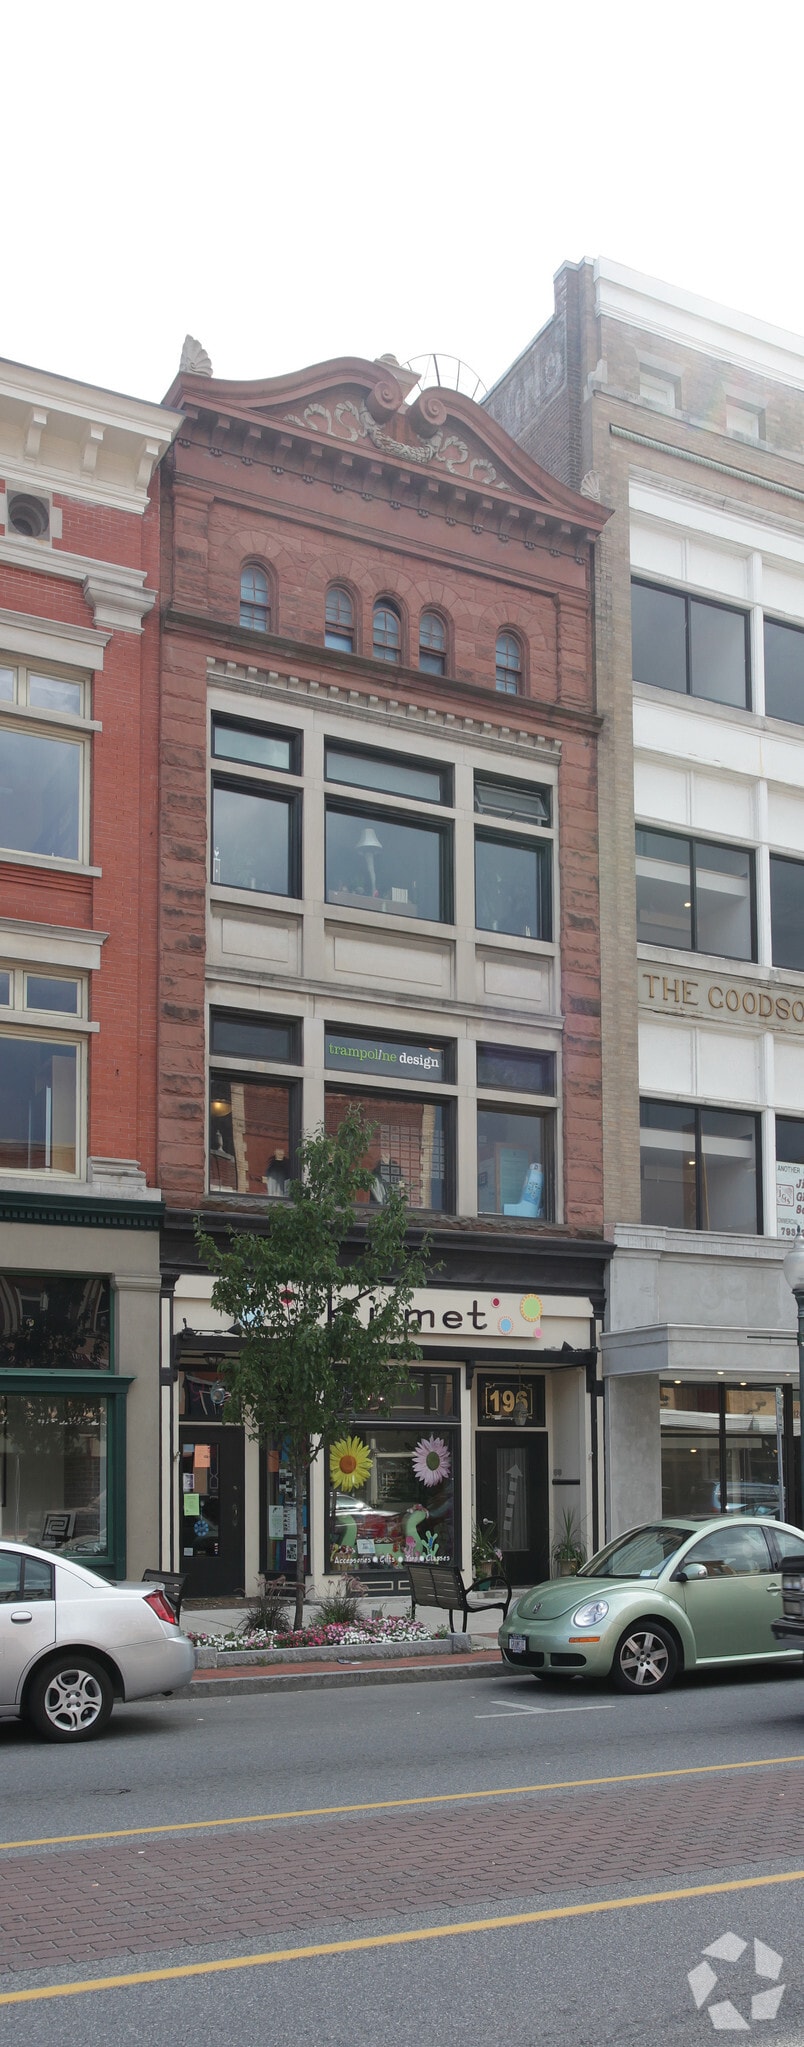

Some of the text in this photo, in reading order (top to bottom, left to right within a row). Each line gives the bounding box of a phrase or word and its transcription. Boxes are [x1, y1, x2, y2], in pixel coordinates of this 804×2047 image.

[643, 974, 698, 1005] THE
[399, 1053, 440, 1070] design
[778, 1165, 800, 1174] ANOTHER
[490, 1390, 528, 1412] 196
[334, 1556, 371, 1564] Accessories
[380, 1554, 395, 1564] Gifts
[426, 1554, 450, 1562] Classes
